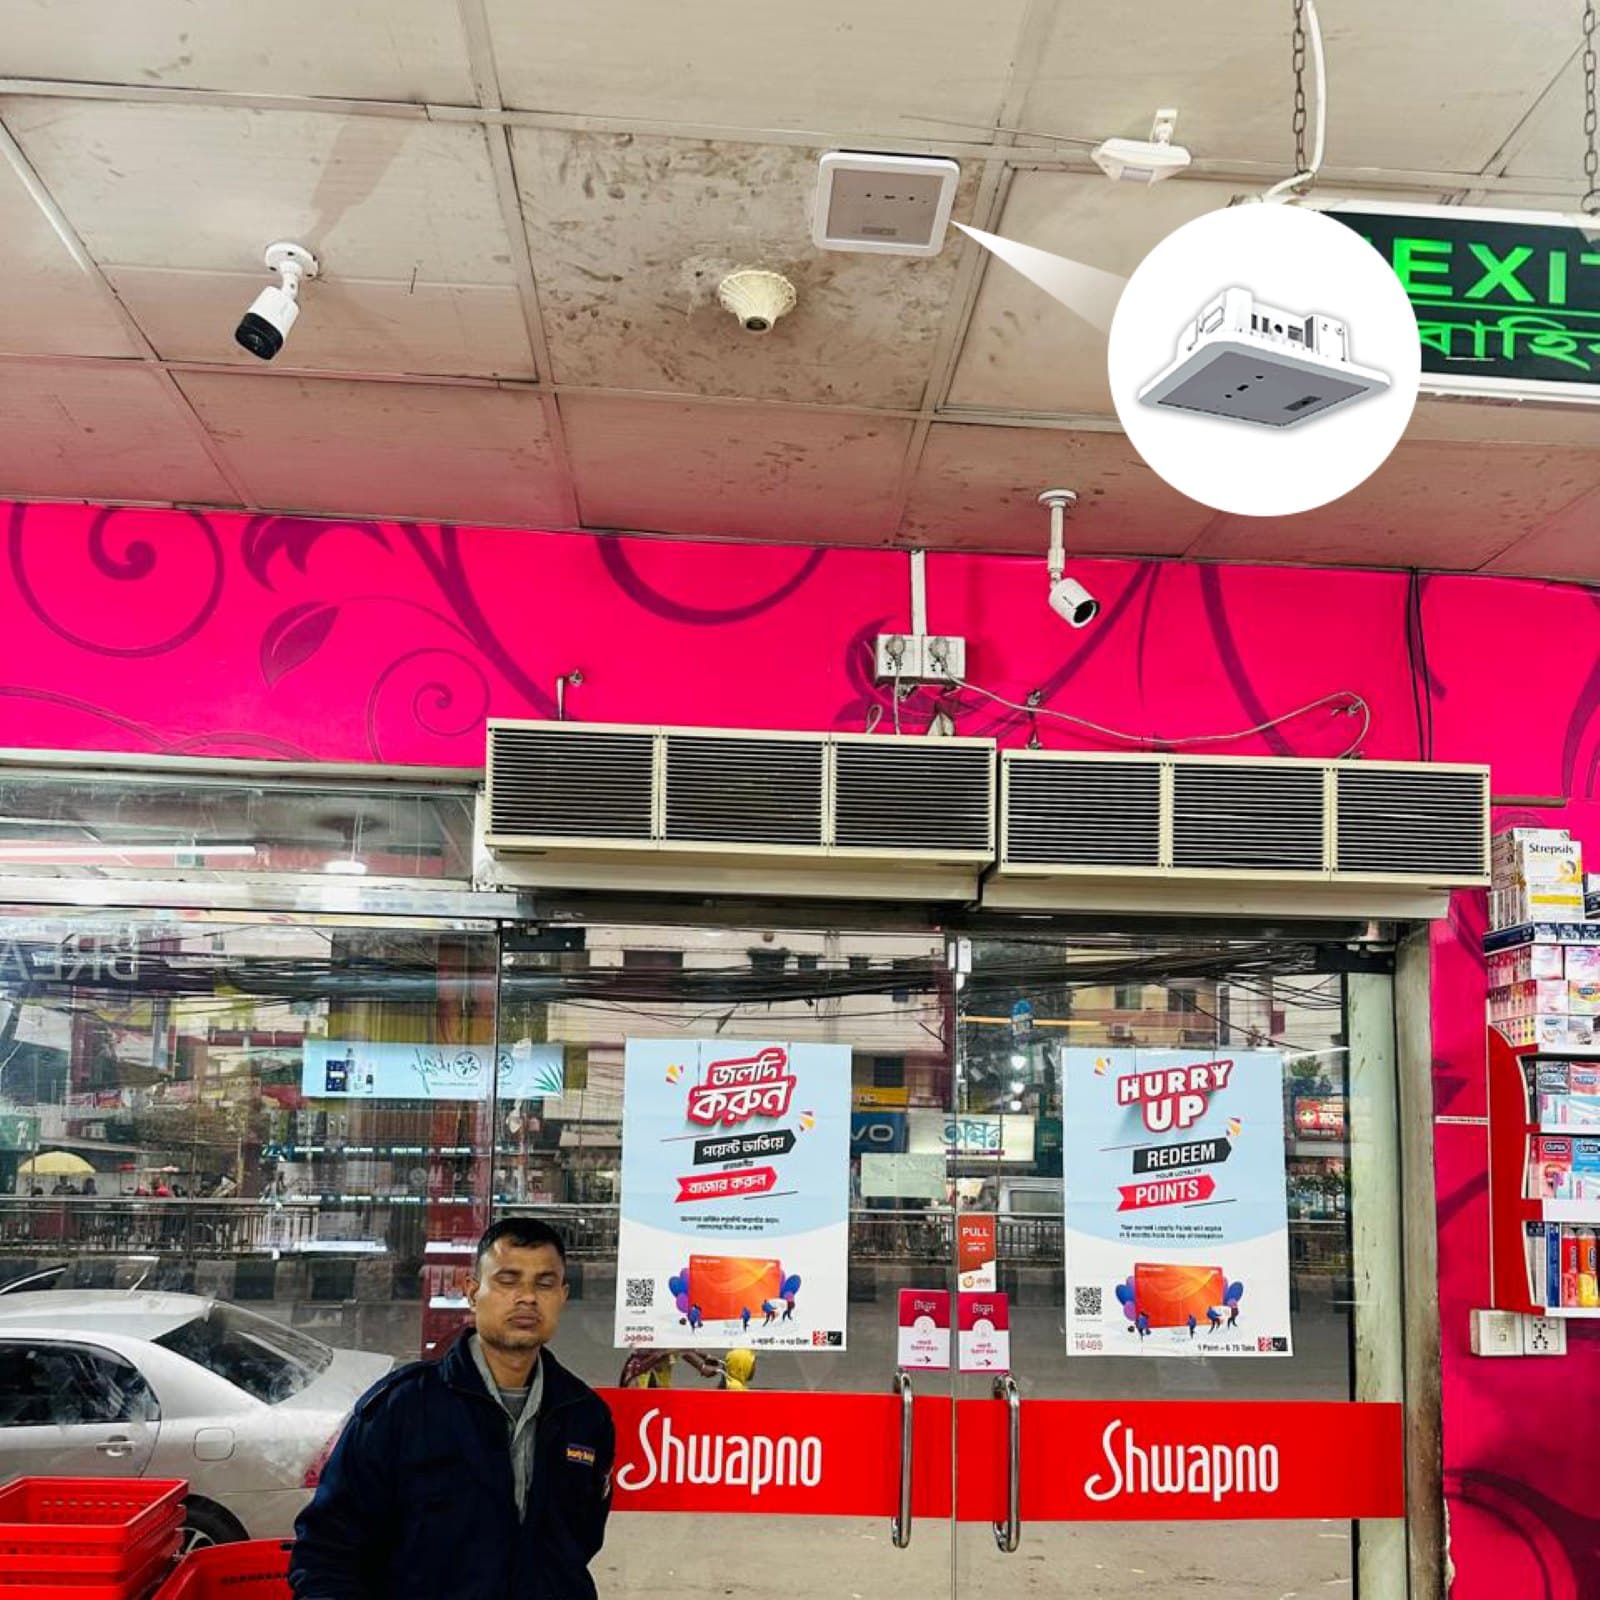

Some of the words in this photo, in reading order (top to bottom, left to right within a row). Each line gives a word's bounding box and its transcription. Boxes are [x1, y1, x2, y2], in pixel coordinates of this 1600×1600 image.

[1416, 316, 1600, 372] বাহি
[1528, 842, 1574, 856] Strepsils
[711, 1052, 782, 1086] জলদি
[1120, 1063, 1230, 1102] HURRY
[692, 1080, 789, 1121] করুন
[1146, 1096, 1205, 1131] UP
[702, 1139, 741, 1158] পয়েন্ট
[1147, 1142, 1216, 1168] REDEEM
[688, 1178, 729, 1194] বাজার
[731, 1174, 767, 1190] করুন
[1135, 1179, 1200, 1205] POINTS
[962, 1227, 990, 1237] PULL
[618, 1409, 821, 1494] Shwapno
[1085, 1420, 1278, 1501] Shwapno
